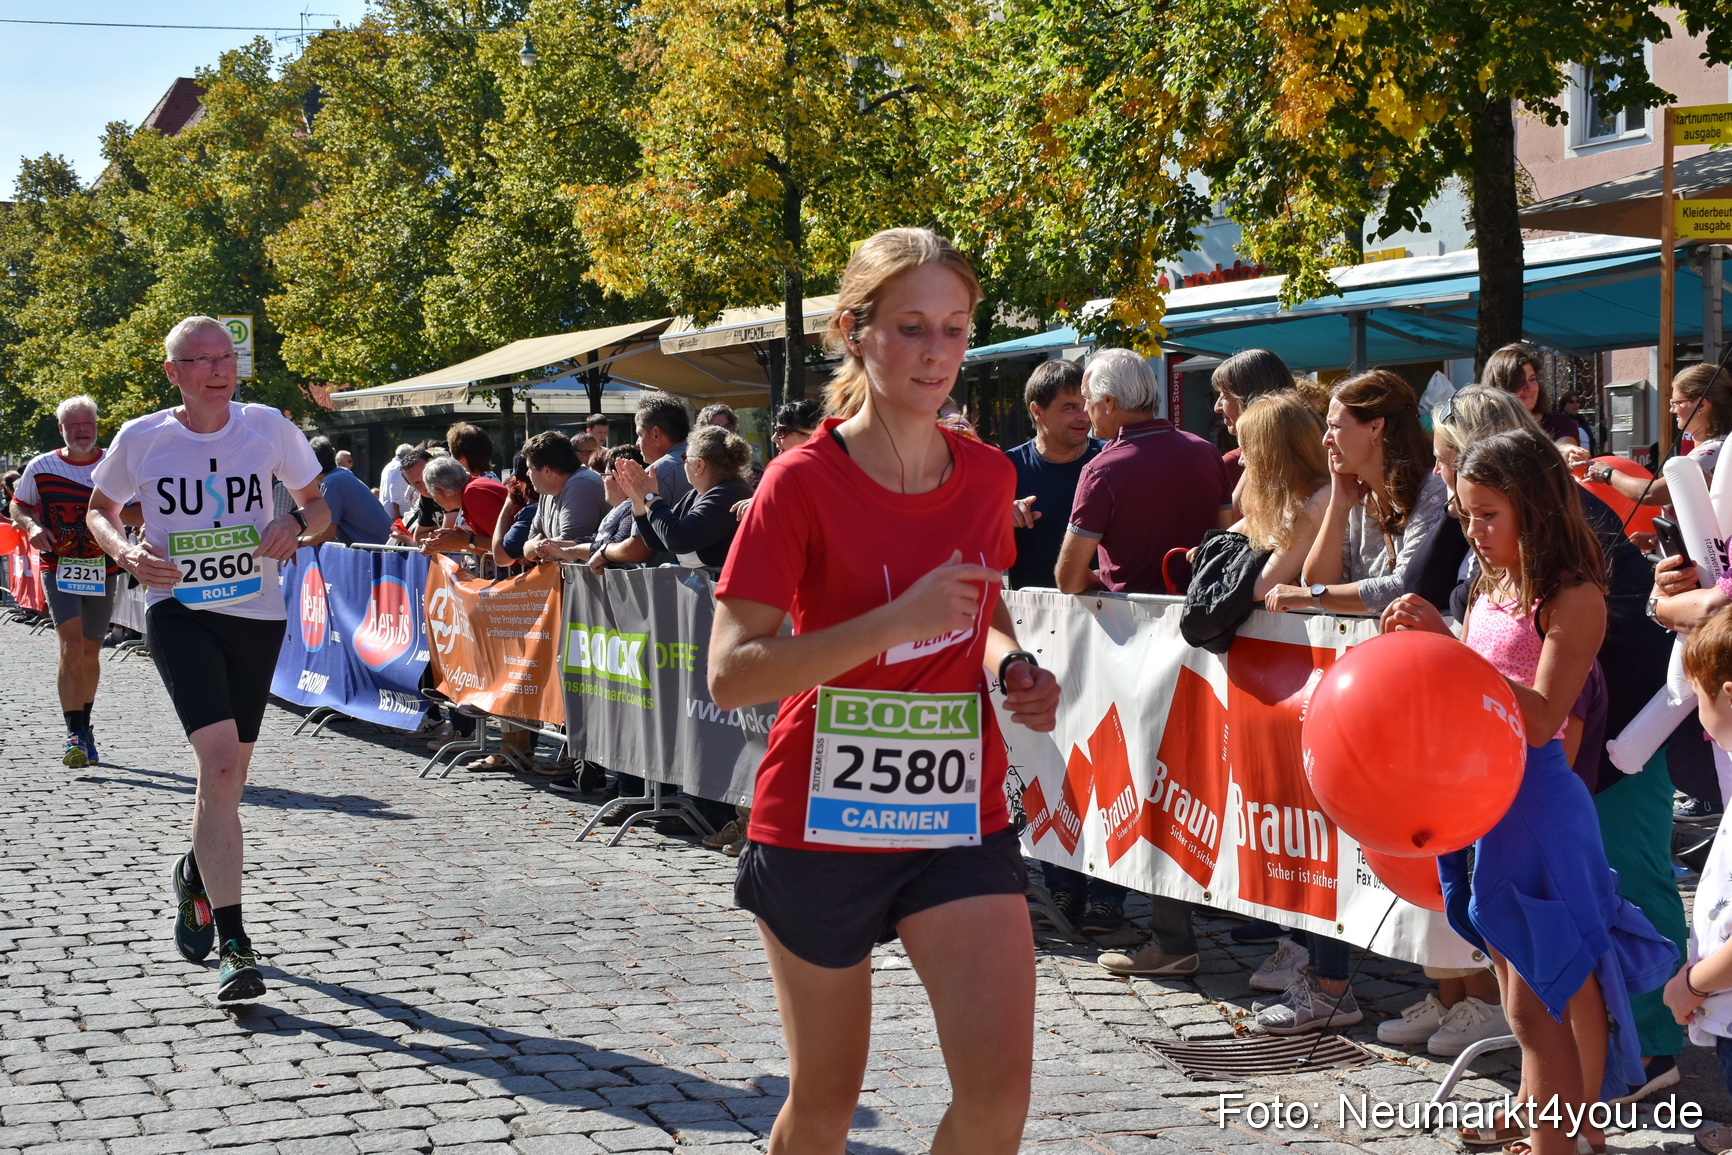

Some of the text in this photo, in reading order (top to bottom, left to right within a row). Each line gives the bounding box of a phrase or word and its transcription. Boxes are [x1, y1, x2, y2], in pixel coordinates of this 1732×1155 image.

[1674, 112, 1732, 125] tartnummern
[1684, 126, 1721, 142] ausgabe
[1693, 220, 1731, 234] ausgabe
[1184, 260, 1268, 288] vodafon
[1172, 372, 1180, 402] Store
[157, 474, 263, 519] SUSPA
[177, 528, 254, 552] BOCK
[63, 567, 99, 581] 2321
[181, 552, 253, 583] 2660
[202, 586, 238, 600] ROLF
[361, 600, 410, 651] Hervis
[567, 629, 643, 681] BOCK
[833, 698, 968, 732] BOCK
[833, 745, 966, 795] 2580
[842, 808, 949, 830] CARMEN
[1056, 791, 1081, 837] Braun
[1100, 784, 1136, 840] Braun
[1144, 759, 1218, 850] Braun
[1029, 807, 1048, 834] Braun
[1231, 780, 1329, 863] Braun
[1170, 824, 1216, 870] Sicher ist sicher
[1357, 848, 1367, 865] Te
[1266, 862, 1338, 890] Sicher ist sicher
[1357, 868, 1371, 887] Fax
